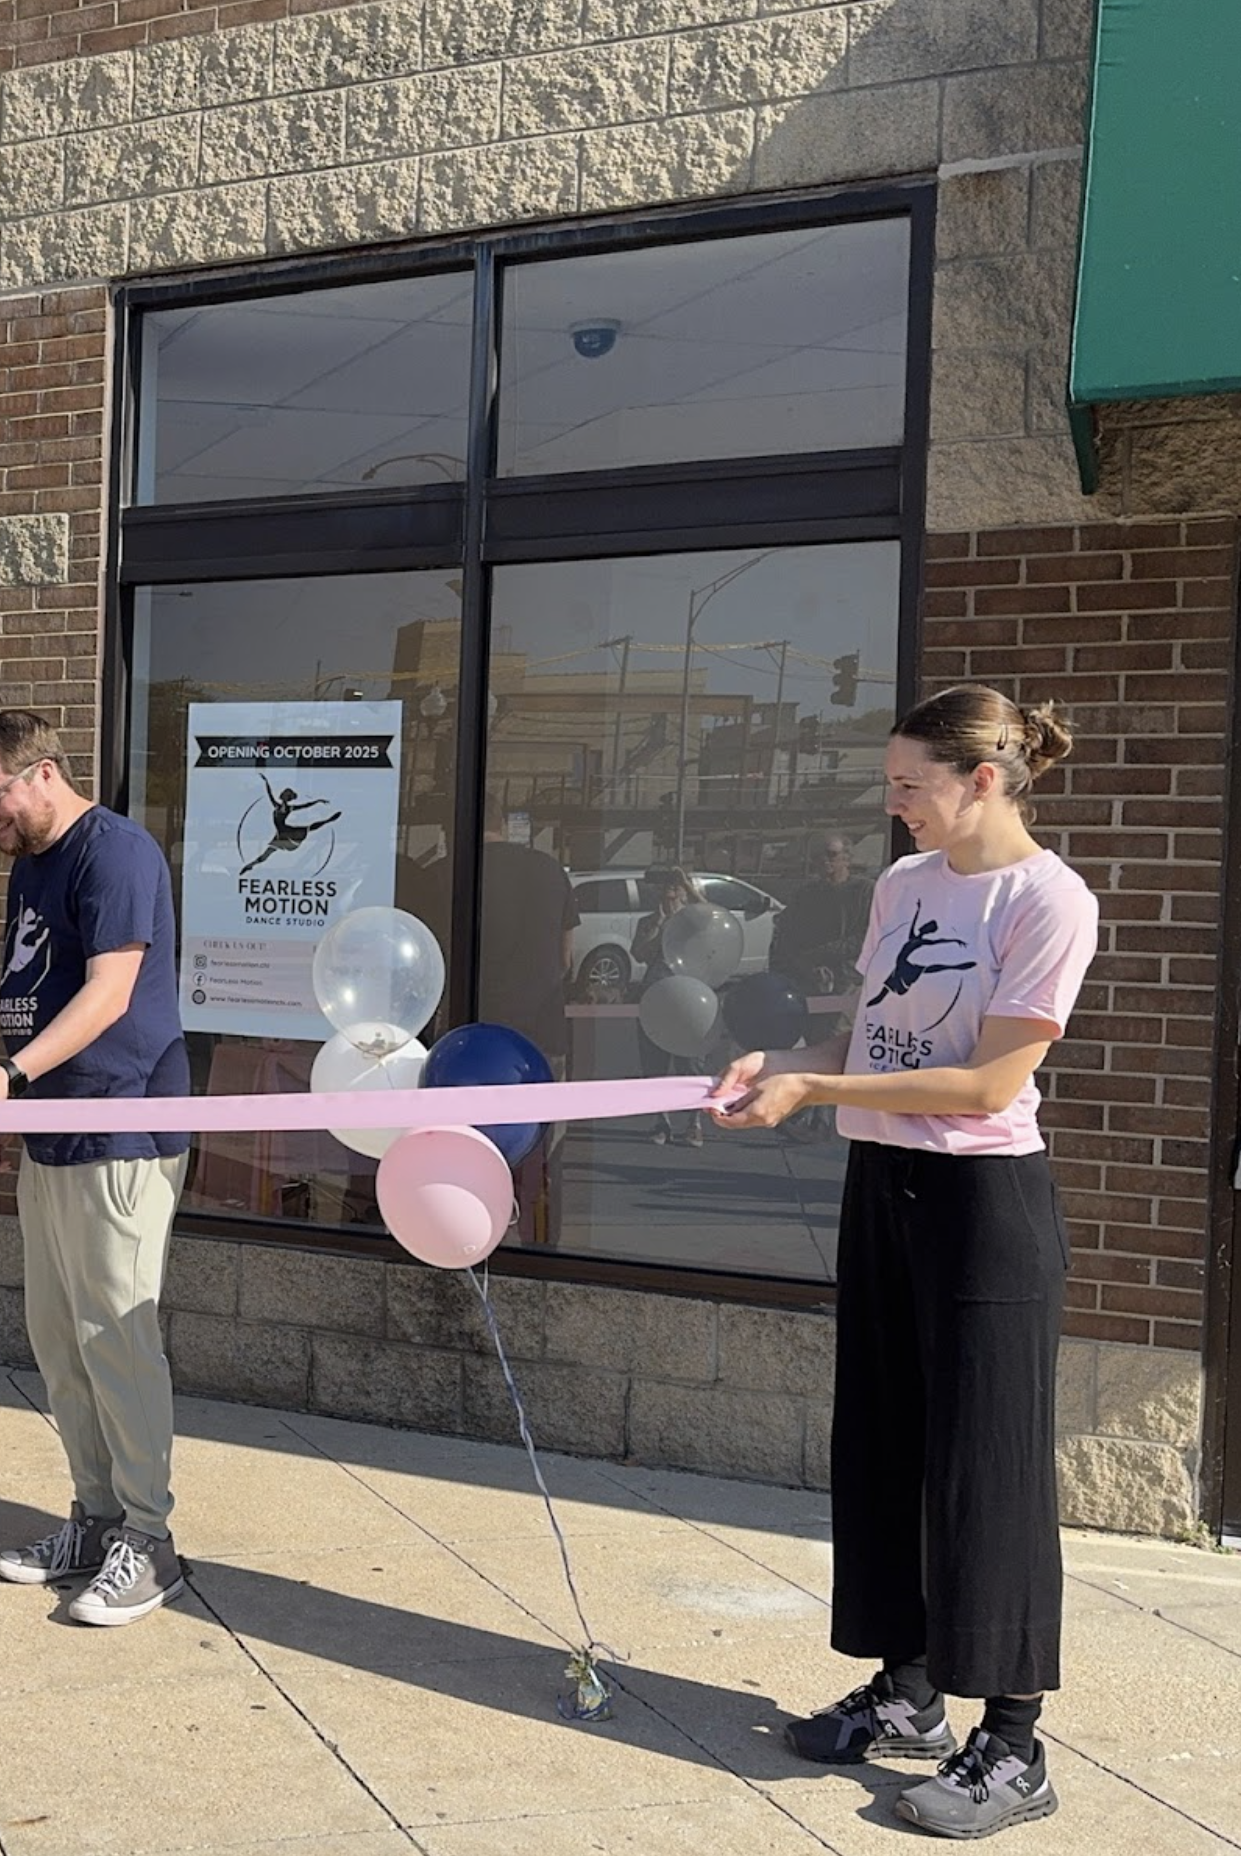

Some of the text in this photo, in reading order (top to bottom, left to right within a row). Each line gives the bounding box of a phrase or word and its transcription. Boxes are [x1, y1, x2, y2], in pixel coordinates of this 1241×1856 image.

[207, 744, 380, 760] OPENING OCTOBER 2025
[238, 878, 337, 898] FEARLESS
[244, 897, 329, 916] MOTION
[245, 915, 325, 928] DANCE STUDIO
